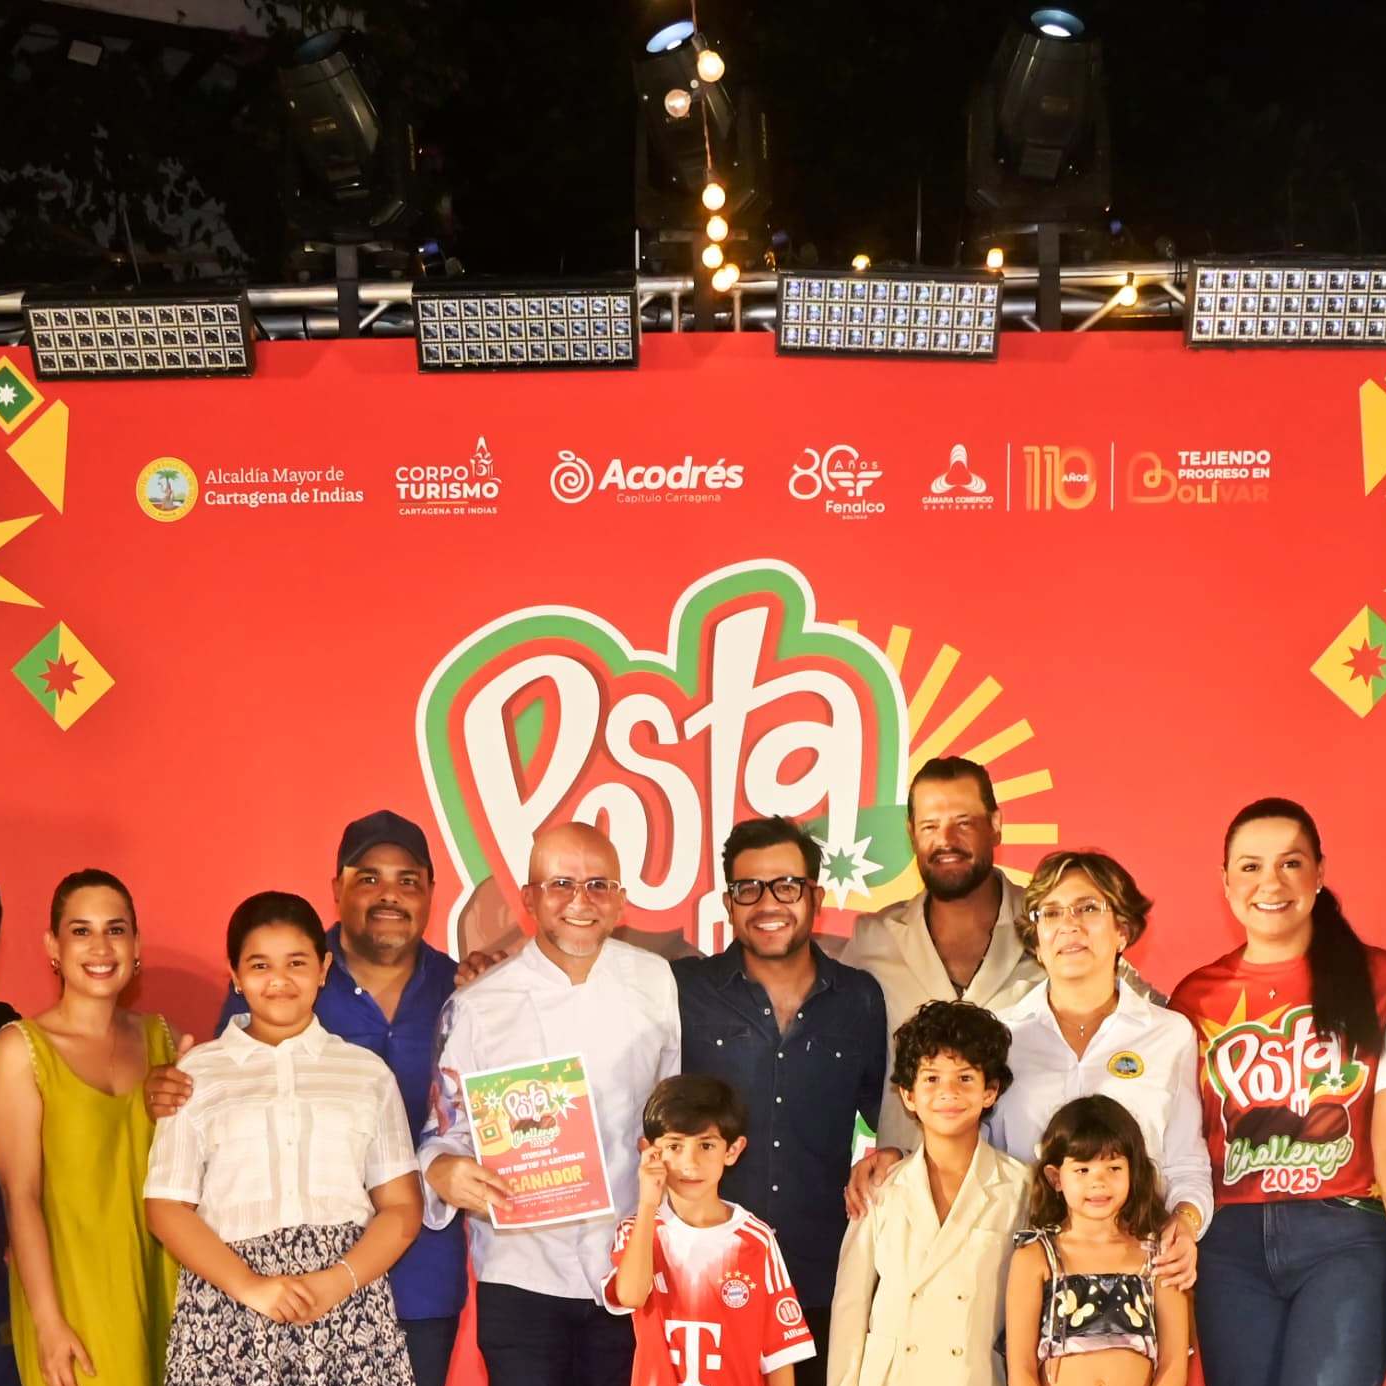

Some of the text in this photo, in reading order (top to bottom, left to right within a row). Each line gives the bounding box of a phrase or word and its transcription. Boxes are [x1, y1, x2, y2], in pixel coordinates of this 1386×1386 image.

[834, 459, 878, 470] Años
[1178, 450, 1271, 466] TEJIENDO
[204, 466, 344, 485] Alcaldía Mayor de
[395, 466, 469, 481] CORPO
[598, 456, 744, 490] Acodrés
[1061, 472, 1089, 482] AÑOS
[1178, 468, 1270, 479] PROGRESO EN
[204, 487, 364, 508] Cartagena de Indias
[395, 482, 500, 499] TURISMO
[665, 492, 722, 504] Cartagena
[825, 499, 886, 513] Fenalco
[955, 495, 994, 504] COMERCIO
[399, 506, 498, 515] CARTAGENA DE INDIAS
[463, 606, 863, 957] Pasta
[1216, 1016, 1341, 1118] Pasta
[1223, 1135, 1353, 1183] Challenge
[509, 1165, 583, 1193] GANADOR
[1263, 1168, 1320, 1191] 2025
